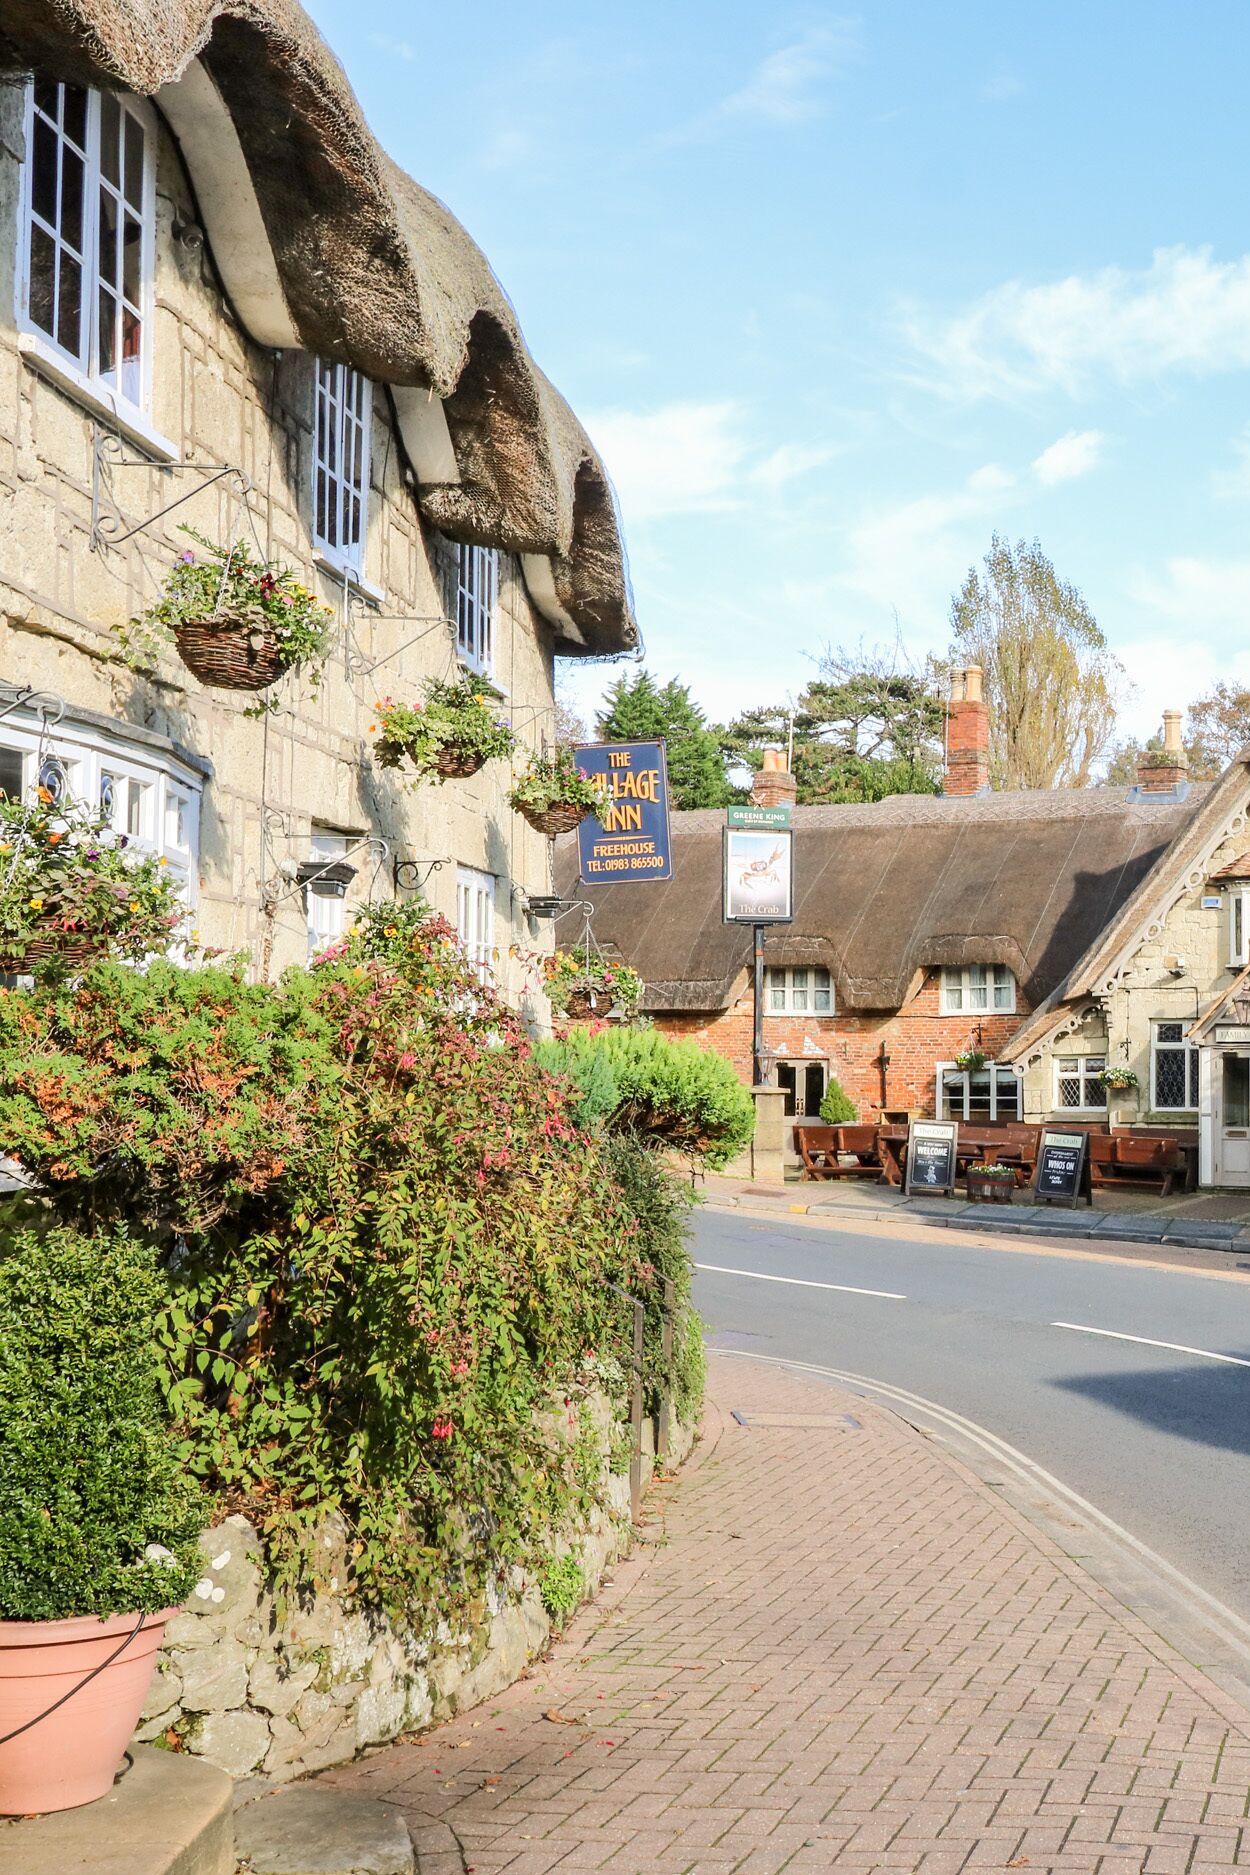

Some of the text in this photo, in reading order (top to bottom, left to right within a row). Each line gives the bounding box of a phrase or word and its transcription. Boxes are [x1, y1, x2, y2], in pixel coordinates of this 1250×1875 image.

[608, 752, 632, 768] THE
[733, 811, 764, 820] GREENE
[765, 813, 786, 822] KING
[593, 842, 656, 858] FREEHOUSE
[587, 856, 664, 873] TEL:01983 865500
[738, 904, 779, 914] The Crab
[1220, 1031, 1248, 1039] FAMILY
[917, 1145, 949, 1157] WELCOME
